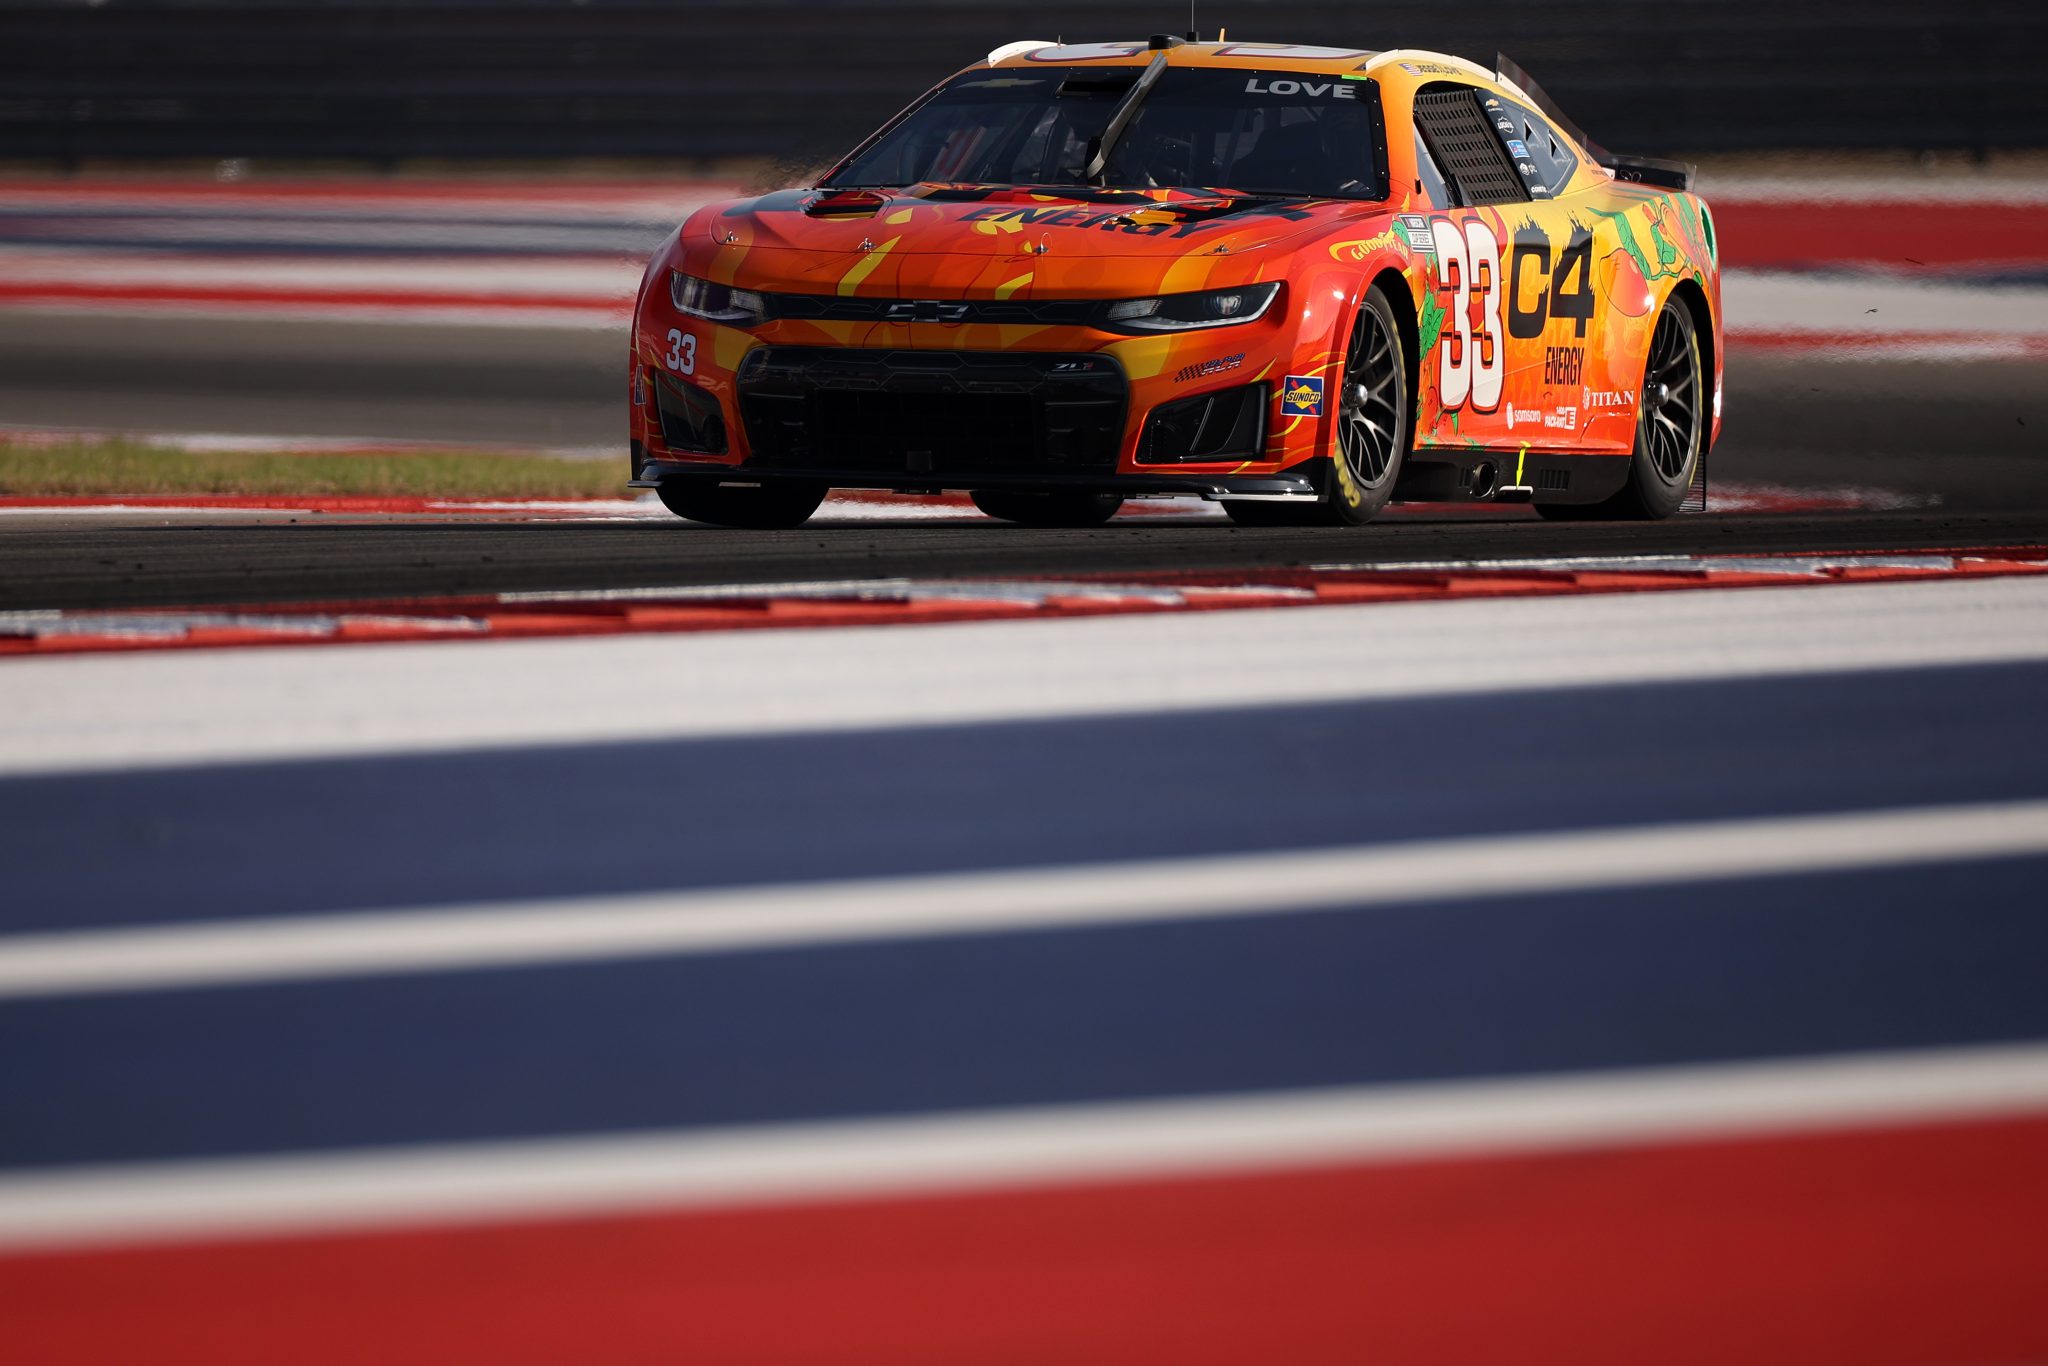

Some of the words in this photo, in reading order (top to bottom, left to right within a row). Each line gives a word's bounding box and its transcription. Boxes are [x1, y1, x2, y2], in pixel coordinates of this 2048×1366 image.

[1245, 79, 1356, 99] LOVE
[1508, 216, 1595, 339] C4
[1431, 215, 1505, 414] 33
[667, 328, 697, 376] 33
[1544, 346, 1585, 384] ENERGY
[1286, 391, 1322, 403] SUNOCO
[1591, 390, 1635, 407] TITAN
